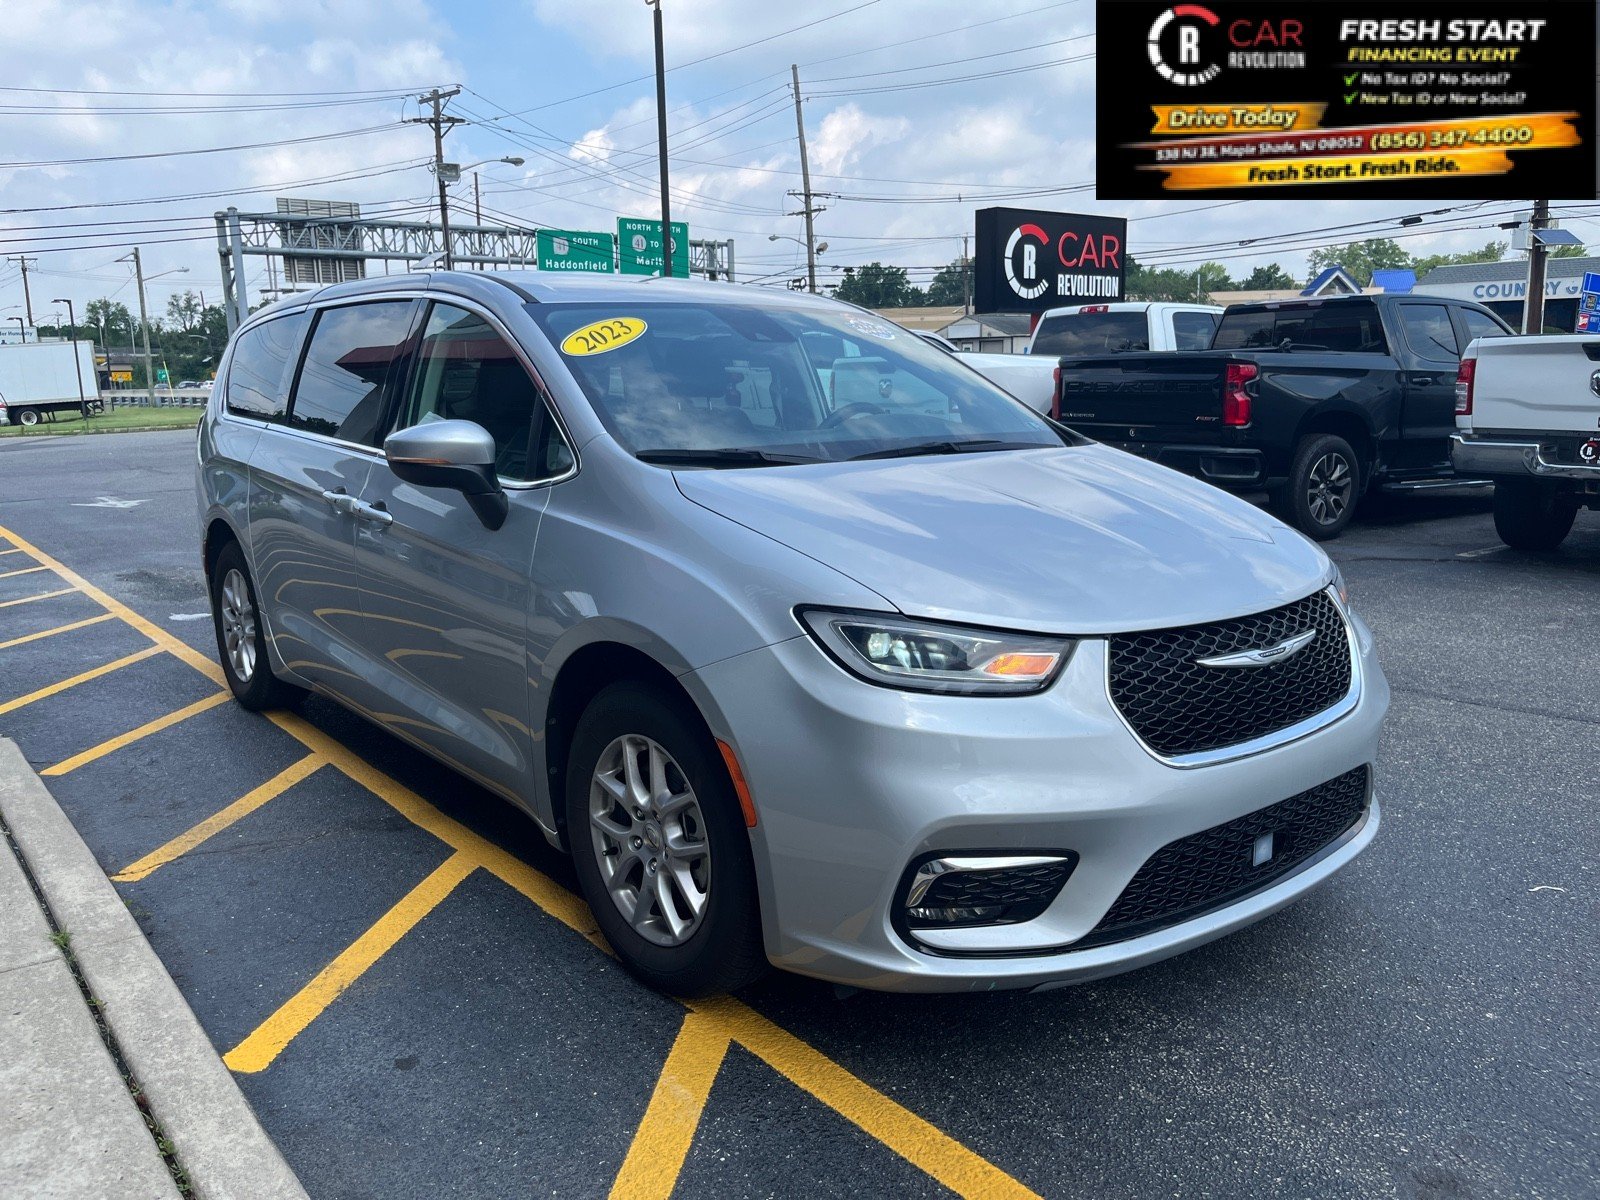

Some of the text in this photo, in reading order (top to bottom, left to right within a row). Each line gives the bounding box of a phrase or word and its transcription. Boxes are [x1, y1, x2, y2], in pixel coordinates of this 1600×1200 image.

[626, 223, 681, 234] NORTH STH
[572, 237, 599, 247] SOUTH
[635, 239, 644, 249] 41
[650, 240, 659, 248] TO
[1058, 231, 1121, 269] CAR
[545, 259, 608, 271] Haddonfield
[1023, 244, 1037, 280] R
[1057, 273, 1119, 298] REVOLUTION
[575, 320, 632, 352] 2023
